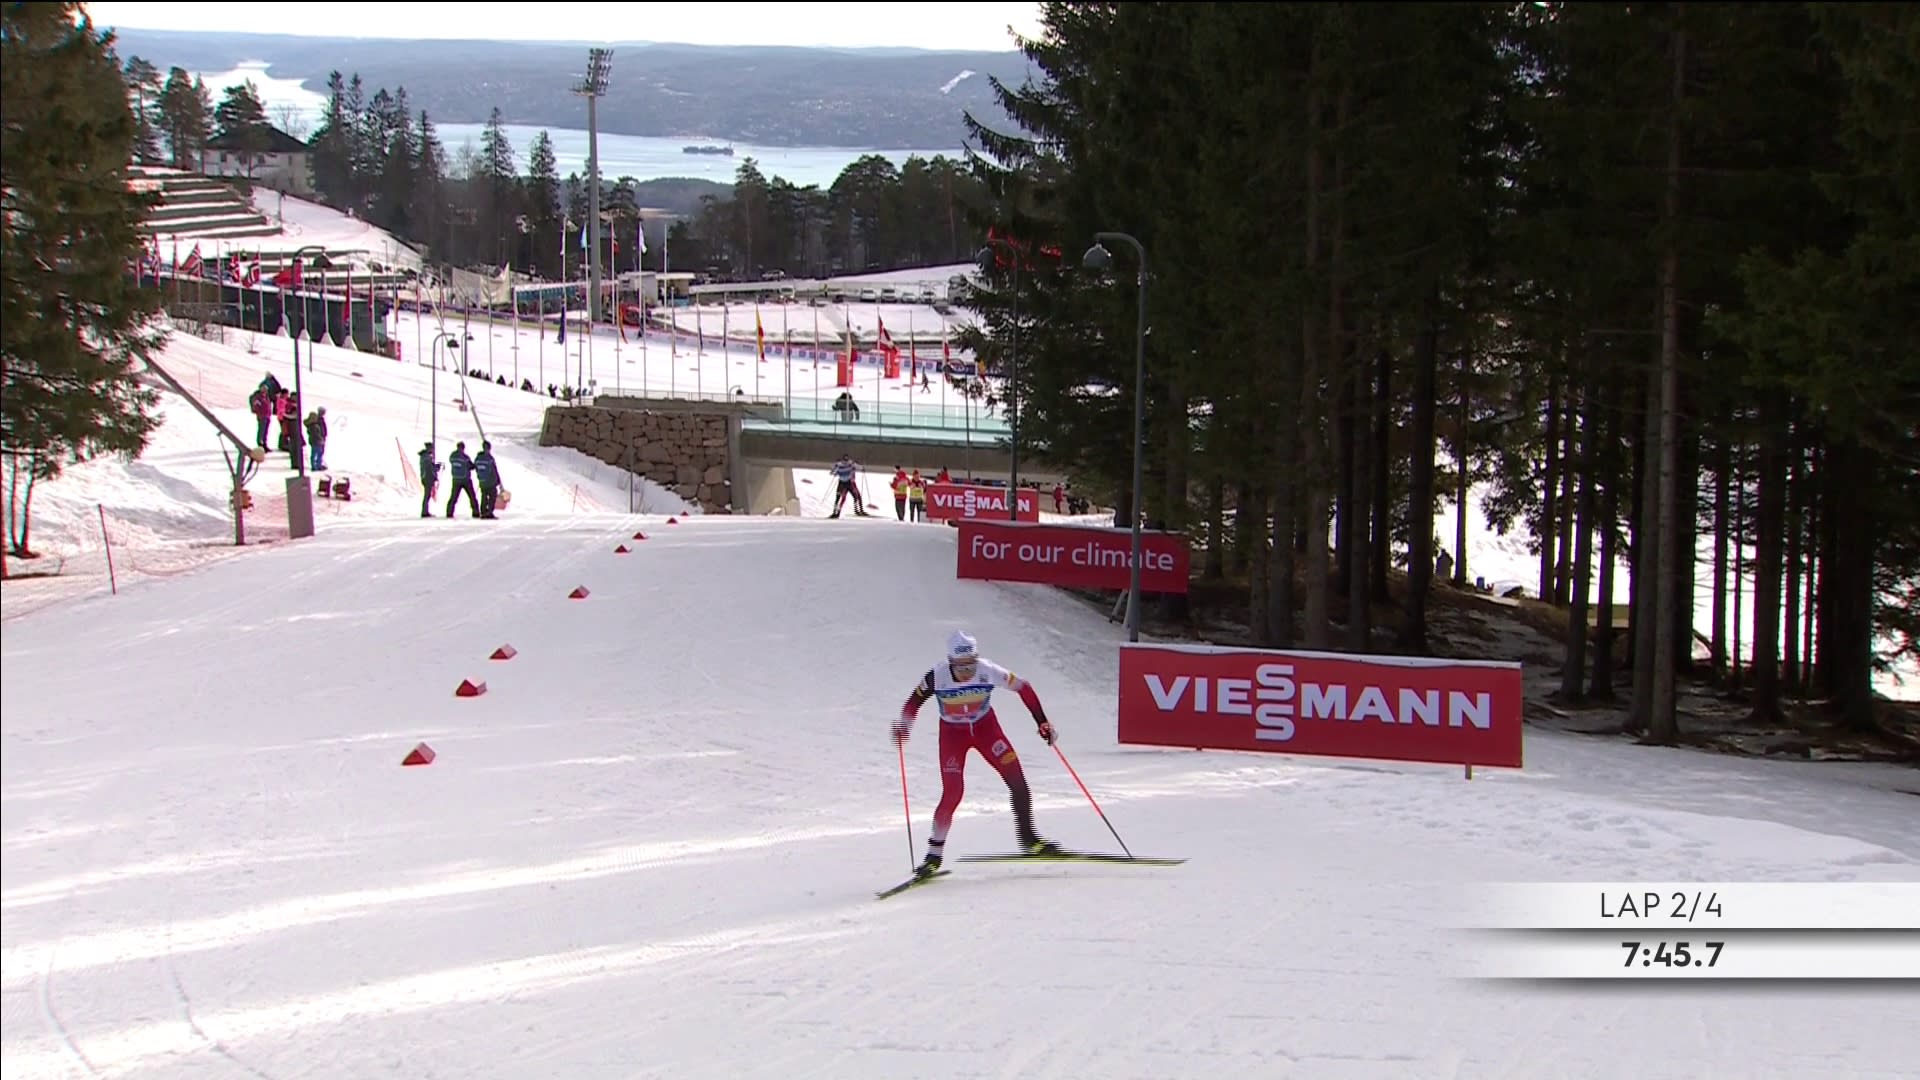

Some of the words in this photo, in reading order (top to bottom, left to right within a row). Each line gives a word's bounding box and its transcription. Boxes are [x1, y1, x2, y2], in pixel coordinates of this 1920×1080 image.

[933, 490, 1030, 517] VIESSMAN
[971, 535, 1012, 560] for
[1018, 544, 1065, 564] our
[1143, 663, 1491, 741] VIESSMANN
